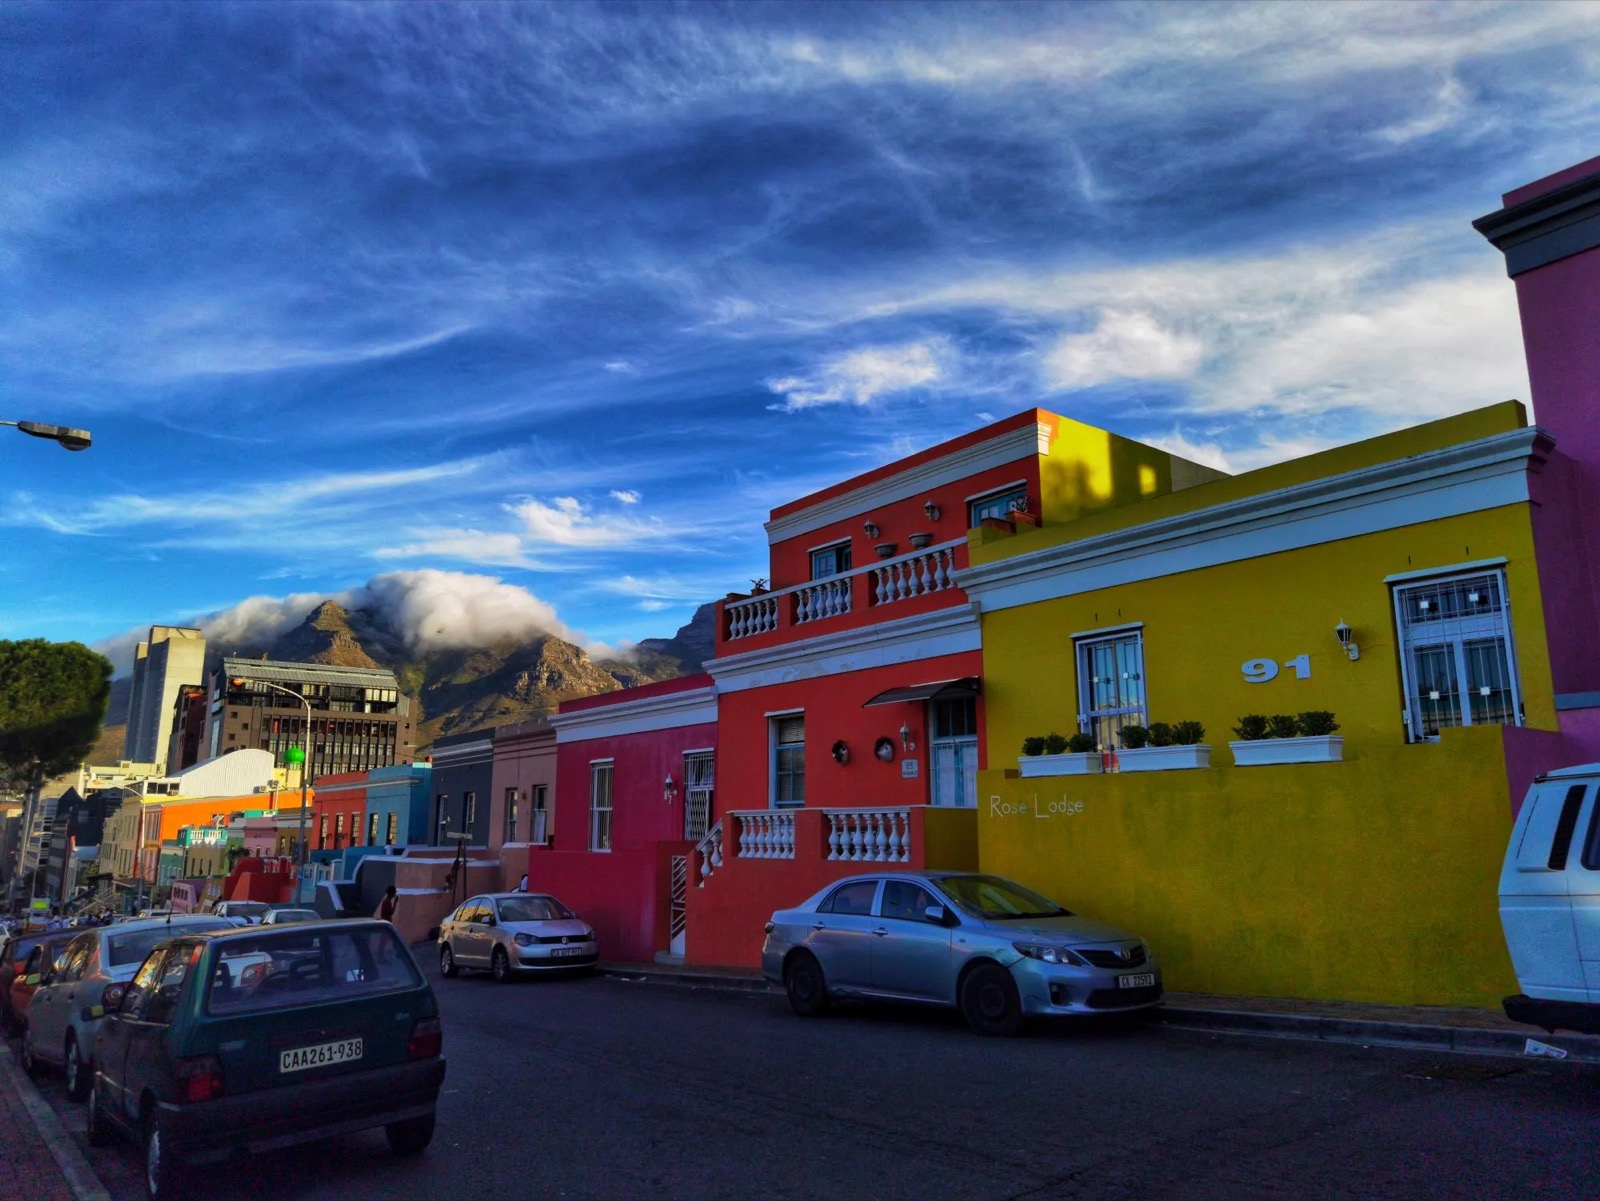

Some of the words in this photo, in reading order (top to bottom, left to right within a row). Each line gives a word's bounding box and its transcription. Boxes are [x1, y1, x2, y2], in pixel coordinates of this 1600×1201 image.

[1241, 653, 1311, 683] 91
[990, 795, 1028, 818] Rose
[1034, 793, 1084, 818] Lodge
[282, 1040, 362, 1069] CAA261-938
